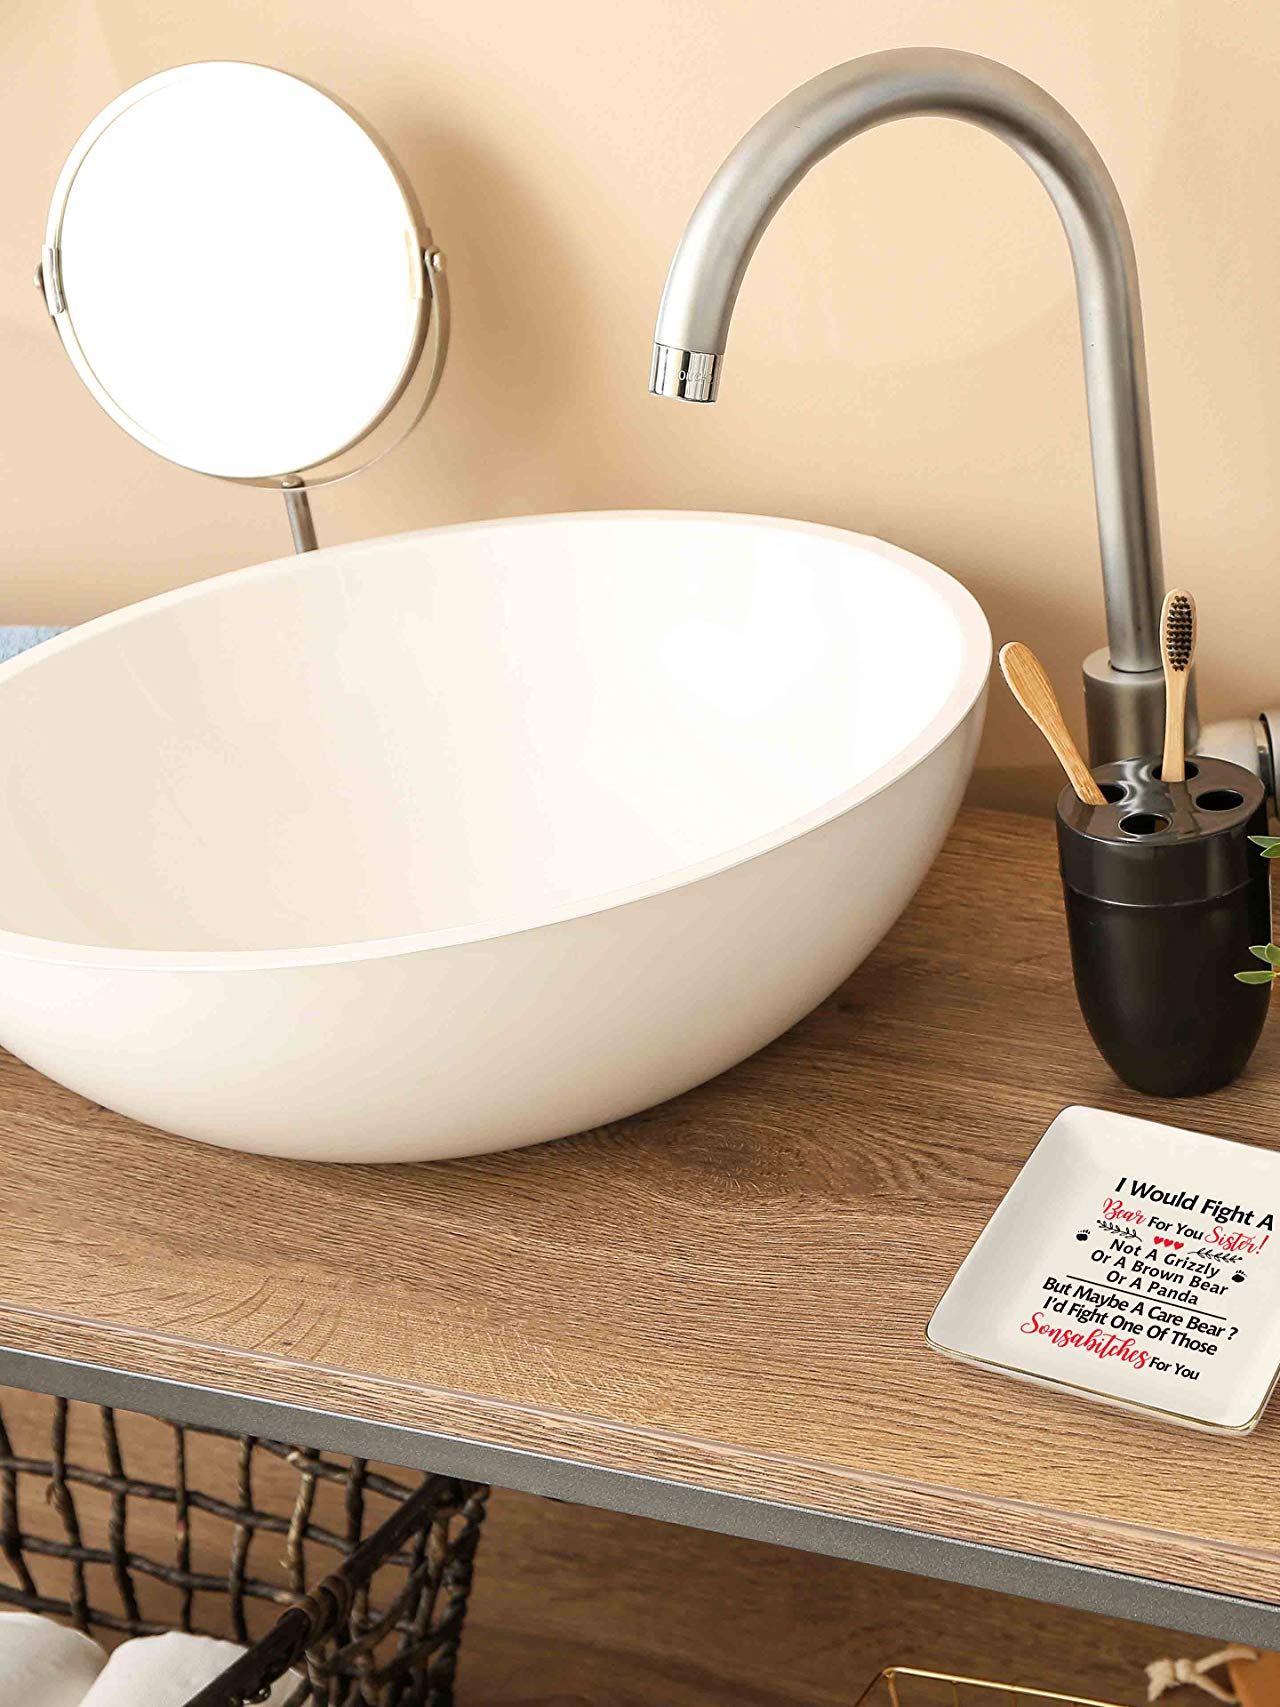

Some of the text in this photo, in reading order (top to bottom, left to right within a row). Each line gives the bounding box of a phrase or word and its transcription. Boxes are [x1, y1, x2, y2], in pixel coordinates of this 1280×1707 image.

[1102, 1197, 1270, 1255] Bear For You Sister!
[1115, 1178, 1274, 1231] I Would Fight A
[1091, 1250, 1229, 1296] Or A Brown Bear
[1110, 1239, 1221, 1279] Not A Grizzly
[1043, 1277, 1073, 1296] But
[1073, 1285, 1129, 1311] Maybe
[1130, 1302, 1144, 1316] A
[1148, 1306, 1183, 1327] Care
[1106, 1270, 1199, 1305] Or A Panda
[1020, 1311, 1200, 1381] Sonsabitches For You
[1067, 1303, 1109, 1325] Fight
[1110, 1314, 1144, 1334] One
[1147, 1325, 1170, 1342] Of
[1170, 1331, 1218, 1356] Those
